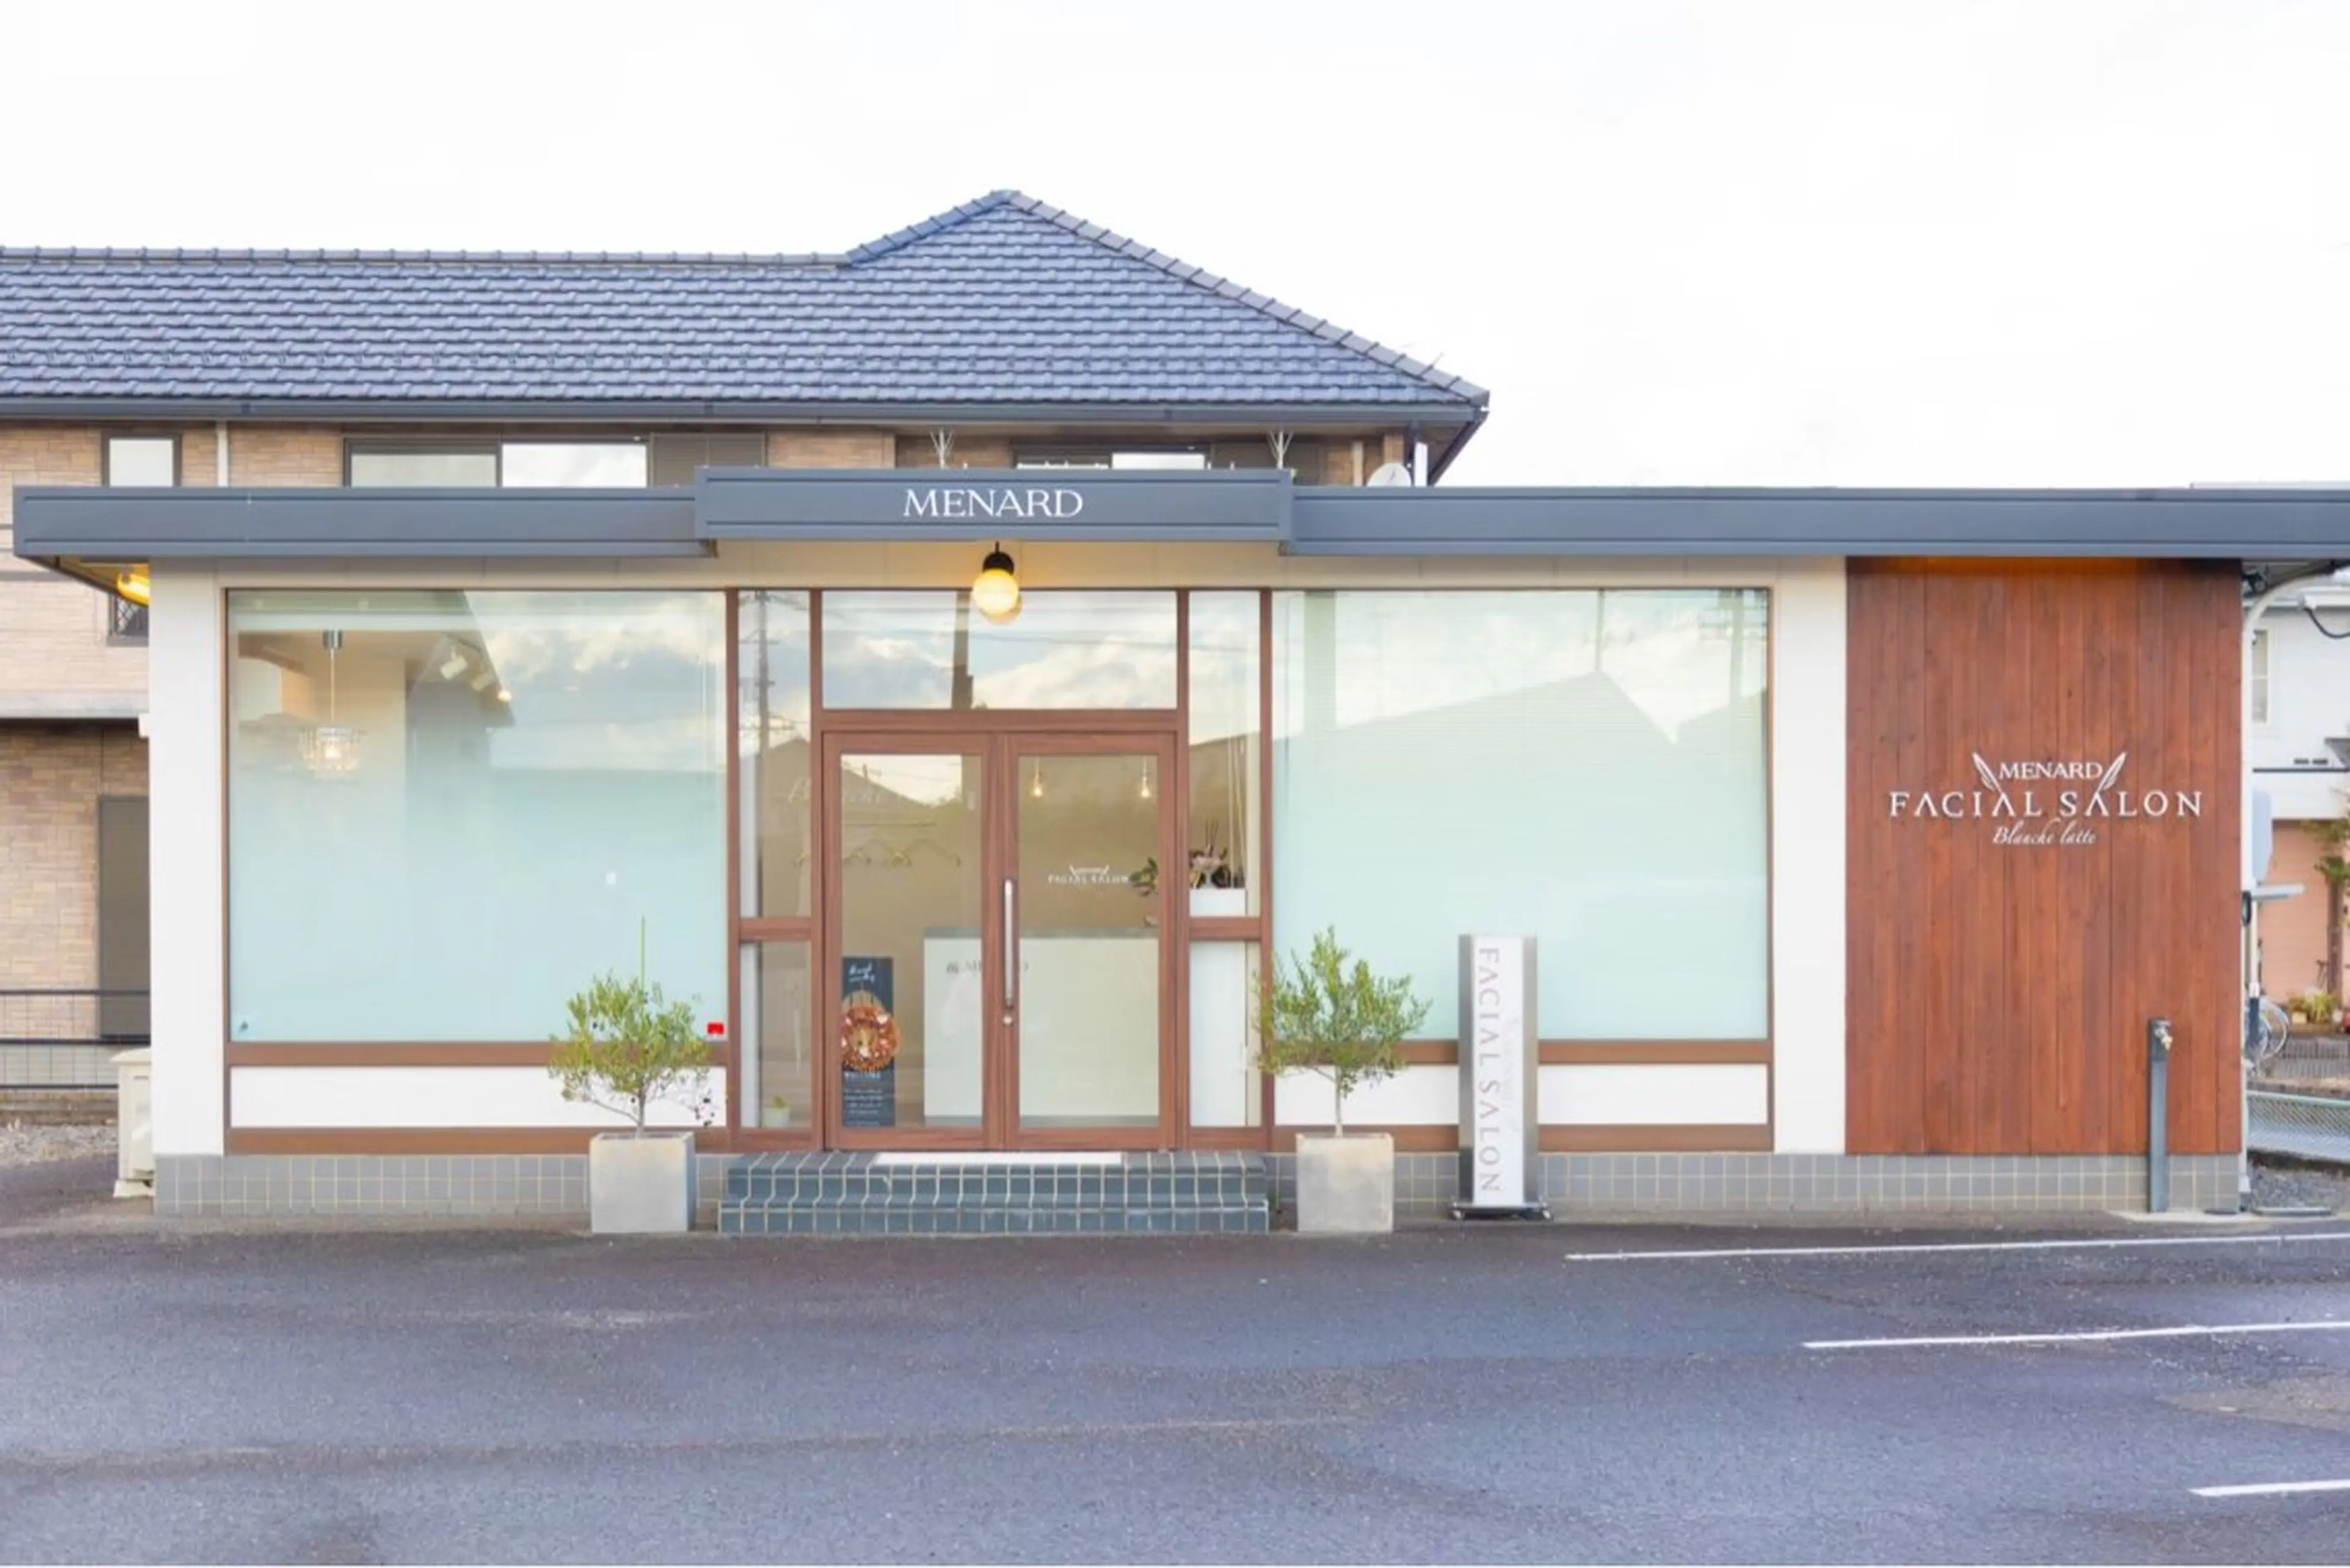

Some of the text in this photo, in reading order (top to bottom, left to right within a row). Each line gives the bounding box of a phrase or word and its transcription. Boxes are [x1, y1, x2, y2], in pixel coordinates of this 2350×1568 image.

[903, 488, 1083, 517] MENARD
[1998, 762, 2103, 779] MENARD
[1890, 790, 2203, 817] FACIAL SALON
[1993, 818, 2097, 845] Blanche latte
[1479, 948, 1501, 1192] FACIAL SALON
